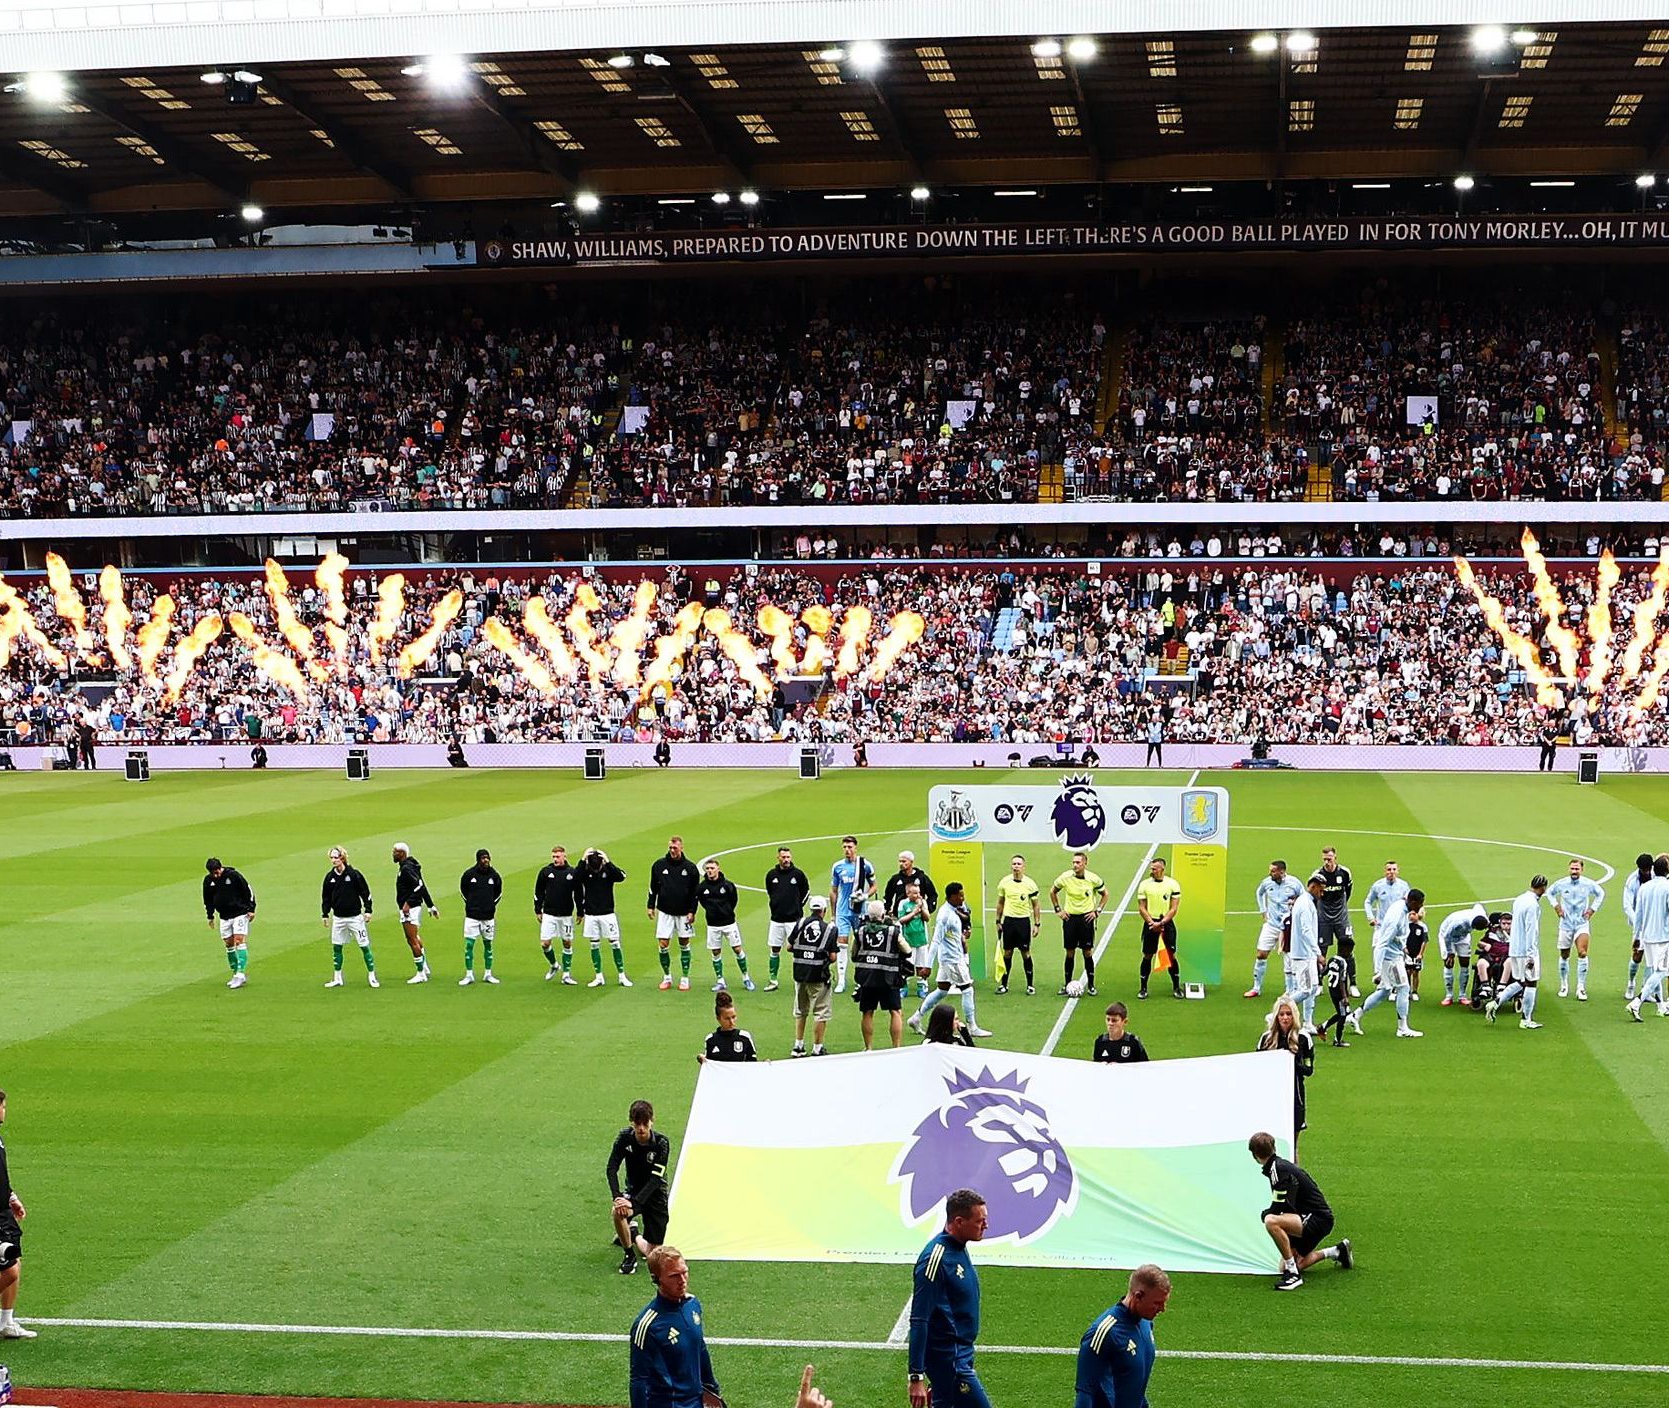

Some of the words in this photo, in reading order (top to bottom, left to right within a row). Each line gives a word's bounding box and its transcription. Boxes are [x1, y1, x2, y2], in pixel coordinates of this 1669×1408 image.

[512, 241, 571, 260] SHAW,
[574, 239, 668, 258] WILLIAMS,
[673, 236, 765, 256] PREPARED
[768, 235, 793, 252] TO
[797, 233, 908, 252] ADVENTURE
[916, 230, 978, 248] DOWN
[982, 229, 1018, 246] THE
[1151, 226, 1164, 243] A
[1168, 225, 1224, 243] GOOD
[1232, 225, 1276, 242] BALL
[1281, 224, 1349, 241] PLAYED
[1359, 223, 1379, 241] IN
[1385, 223, 1422, 241] FOR
[1427, 222, 1481, 240] TONY
[1619, 221, 1639, 239] IT
[998, 807, 1010, 816] EA
[1125, 808, 1137, 817] EA
[358, 929, 367, 938] 10
